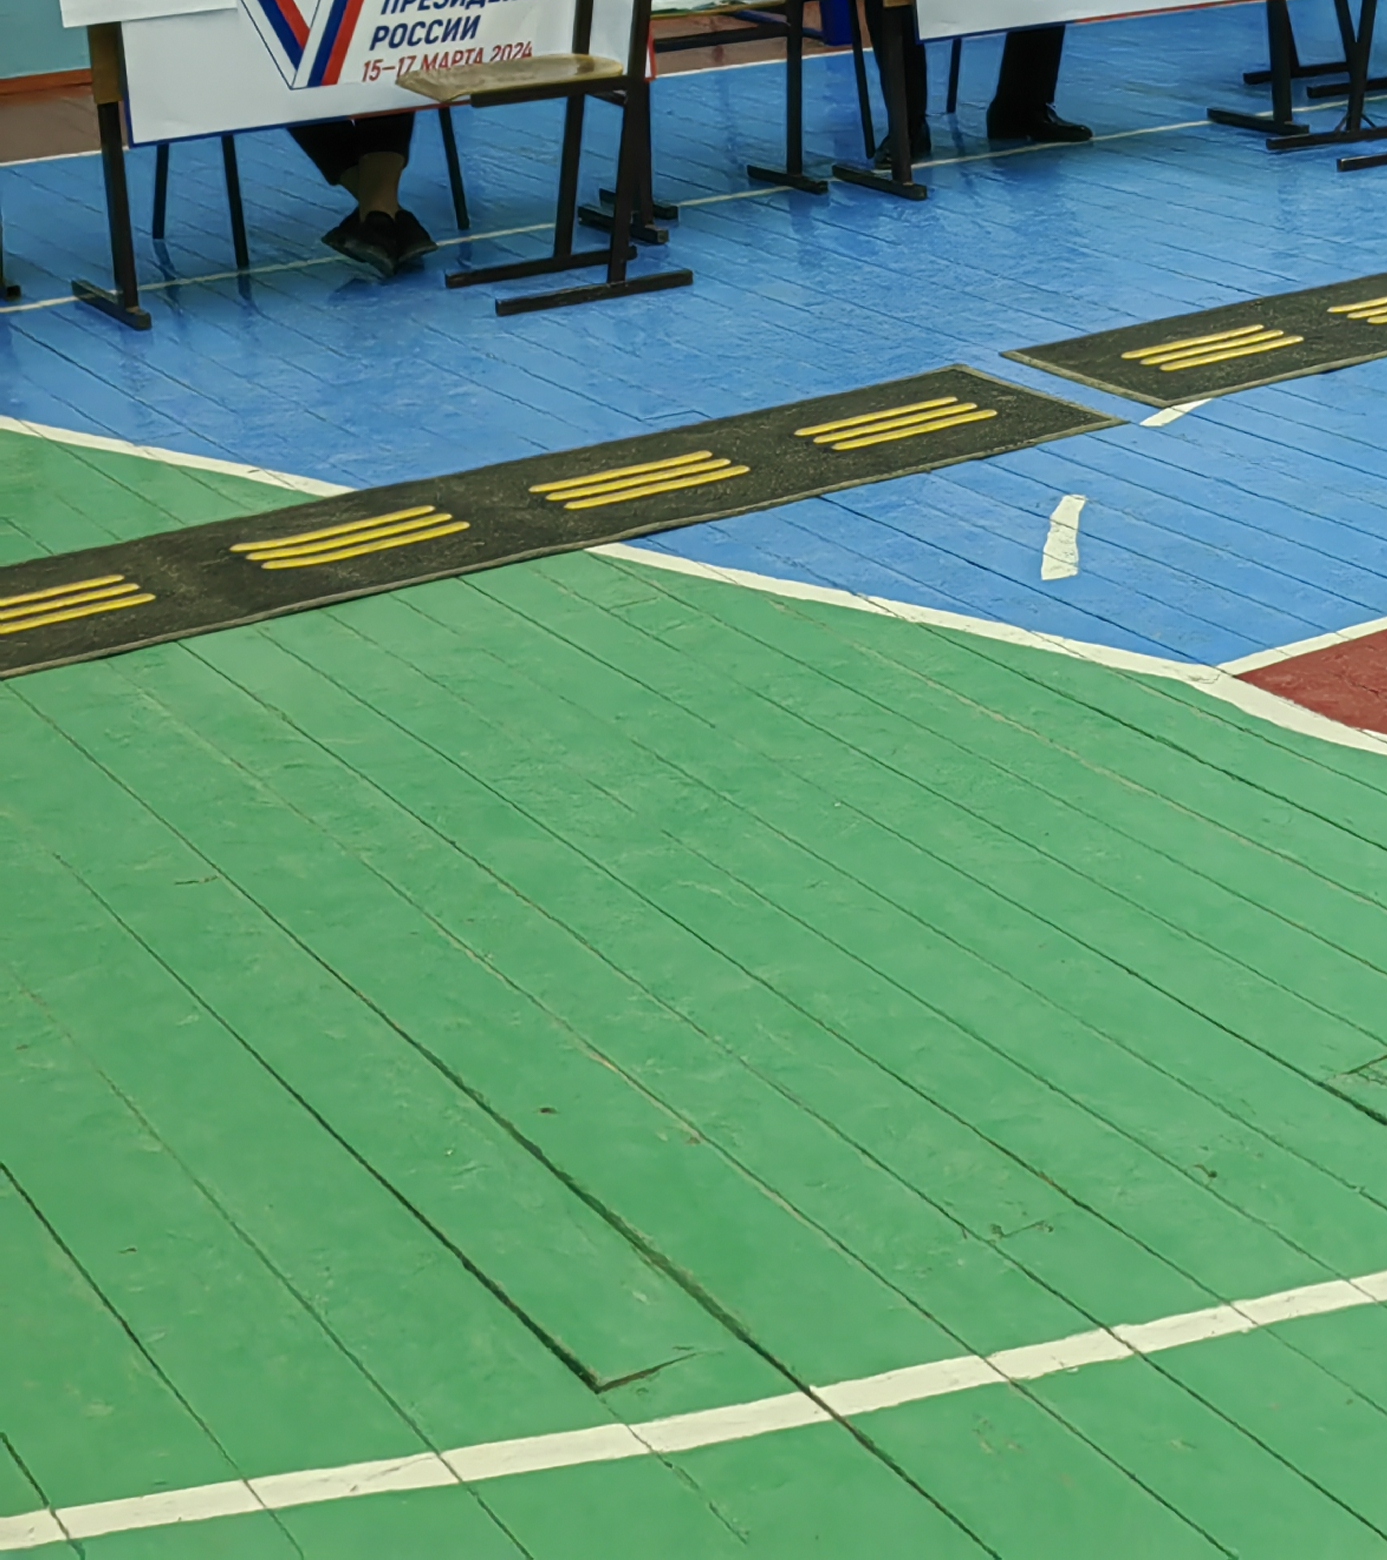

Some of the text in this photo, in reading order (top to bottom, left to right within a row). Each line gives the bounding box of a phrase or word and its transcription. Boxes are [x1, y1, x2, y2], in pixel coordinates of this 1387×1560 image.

[369, 14, 482, 52] РОССИИ
[419, 47, 485, 73] МАРТА
[489, 41, 533, 64] 2024
